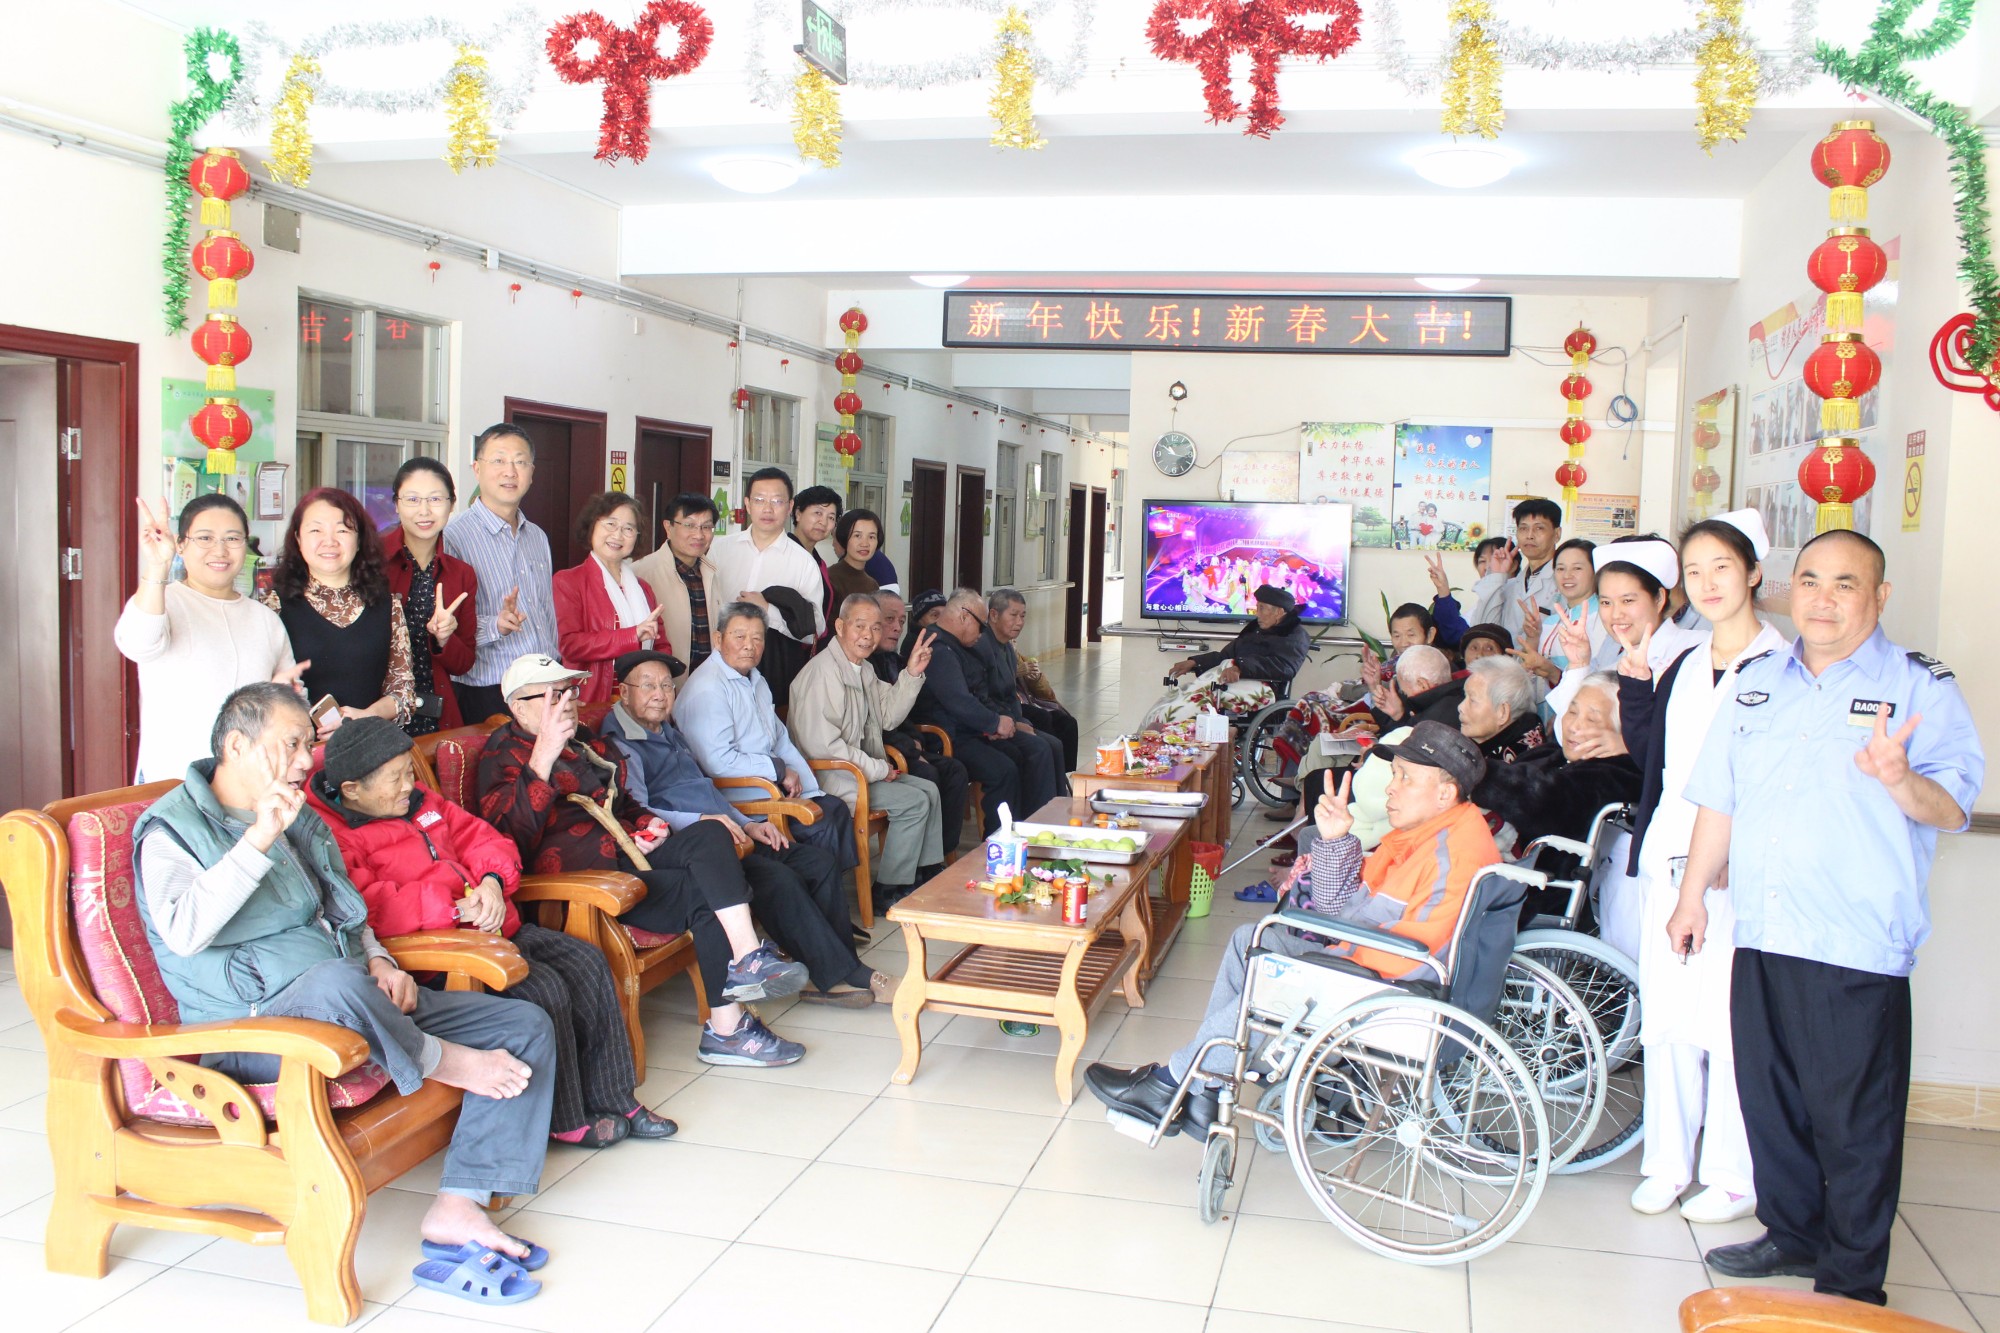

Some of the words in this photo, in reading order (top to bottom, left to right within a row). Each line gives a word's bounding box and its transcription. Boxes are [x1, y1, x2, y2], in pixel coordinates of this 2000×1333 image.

[1340, 455, 1386, 467] 中华民族
[1425, 458, 1480, 471] 今天的老人
[1317, 469, 1374, 481] 尊老敬老的
[1339, 486, 1385, 498] 传统美德
[747, 959, 762, 974] N
[742, 1038, 762, 1055] N
